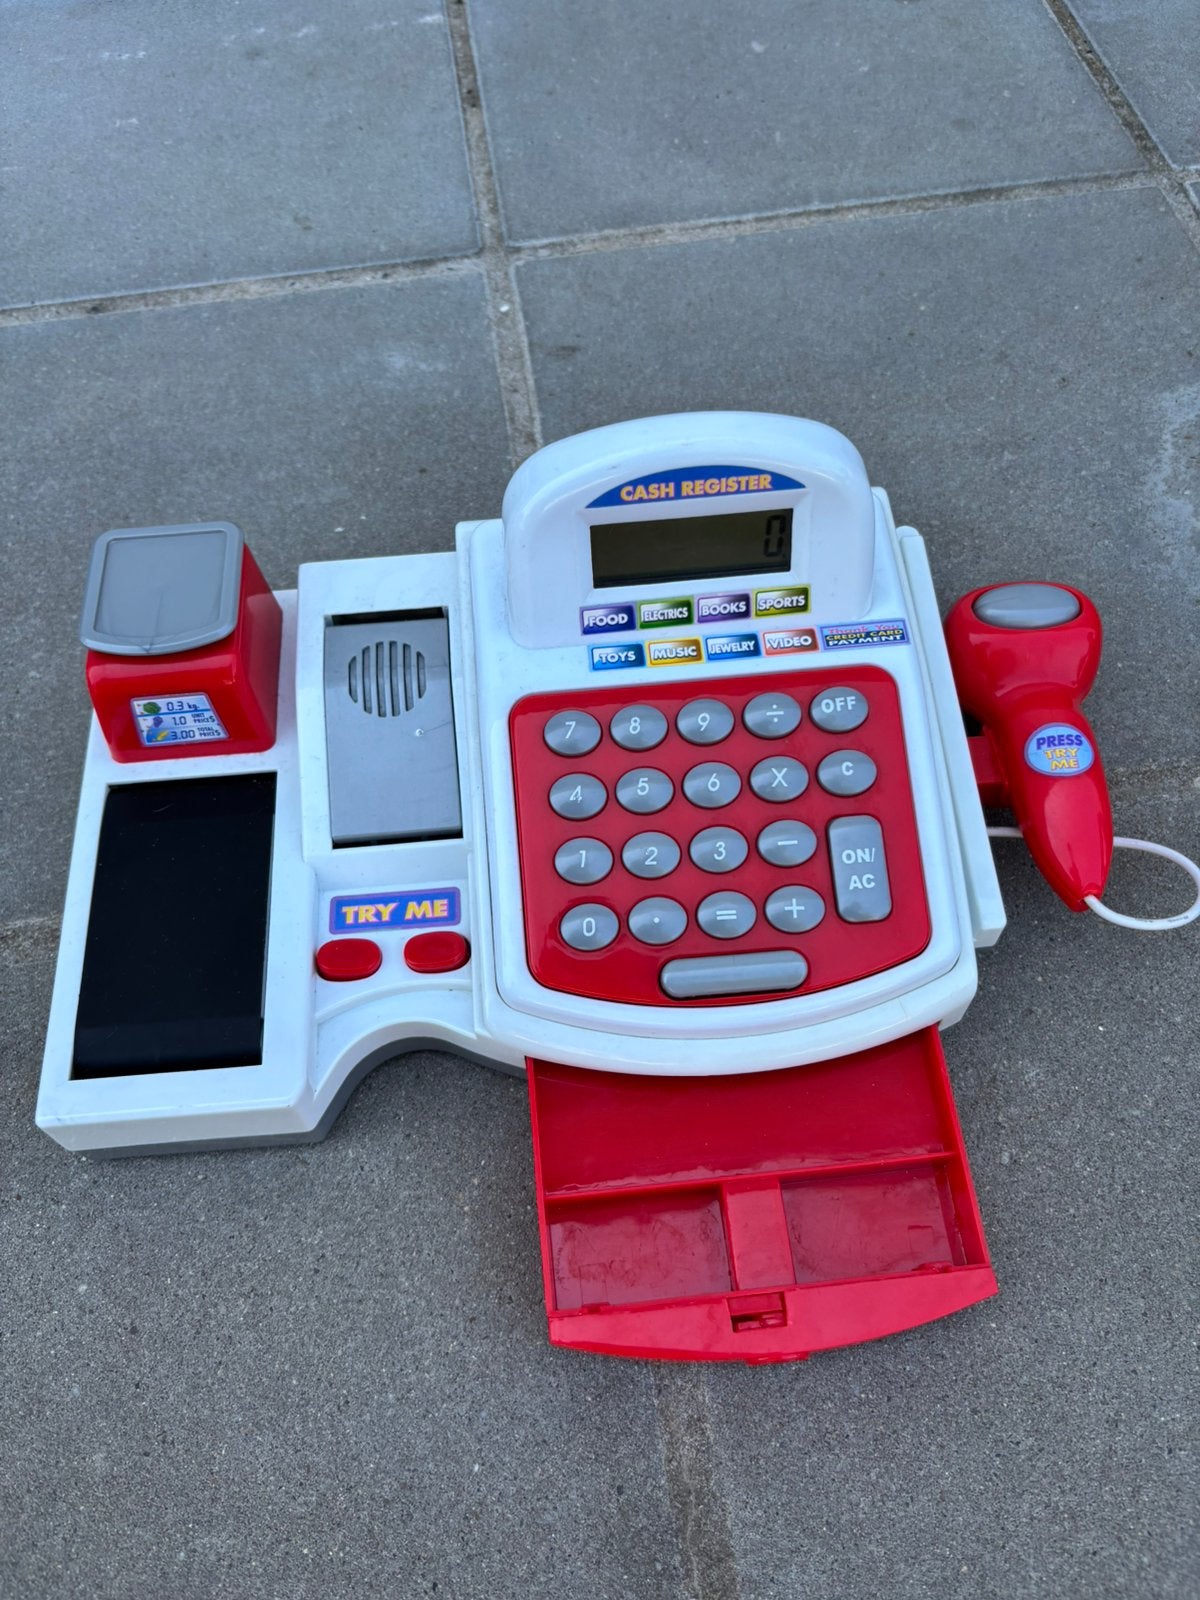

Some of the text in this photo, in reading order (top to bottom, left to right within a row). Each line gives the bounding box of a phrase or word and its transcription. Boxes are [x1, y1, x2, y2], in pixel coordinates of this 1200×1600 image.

[620, 474, 773, 501] CASH REGISTER
[702, 601, 747, 616] BOOKS
[757, 595, 806, 611] SPORTS
[588, 613, 629, 628] FOOD
[644, 607, 689, 622] ELECTRICS
[768, 635, 813, 649] VIDEO
[826, 629, 903, 641] CREDIT CARD
[828, 634, 903, 646] PAYMENT
[654, 646, 698, 660] MUSIC
[709, 640, 756, 654] JEWELRY
[600, 651, 636, 664] TOYS
[166, 701, 184, 712] 0.3
[821, 696, 857, 713] OFF
[172, 716, 187, 726] 1.0
[629, 716, 641, 735] 8
[697, 713, 710, 731] 9
[171, 729, 196, 740] 3.00
[564, 721, 577, 739] 7
[1036, 734, 1083, 750] PRESS
[1044, 747, 1079, 760] TRY
[1050, 759, 1080, 771] ME
[636, 777, 649, 796] 5
[707, 773, 720, 792] 6
[569, 785, 583, 804] 4
[578, 849, 587, 868] 1
[645, 847, 658, 866] 2
[713, 842, 727, 861] 3
[841, 847, 876, 865] ON/
[849, 874, 876, 890] AC
[341, 898, 449, 925] TRY ME
[784, 898, 805, 919] +
[582, 918, 596, 937] 0
